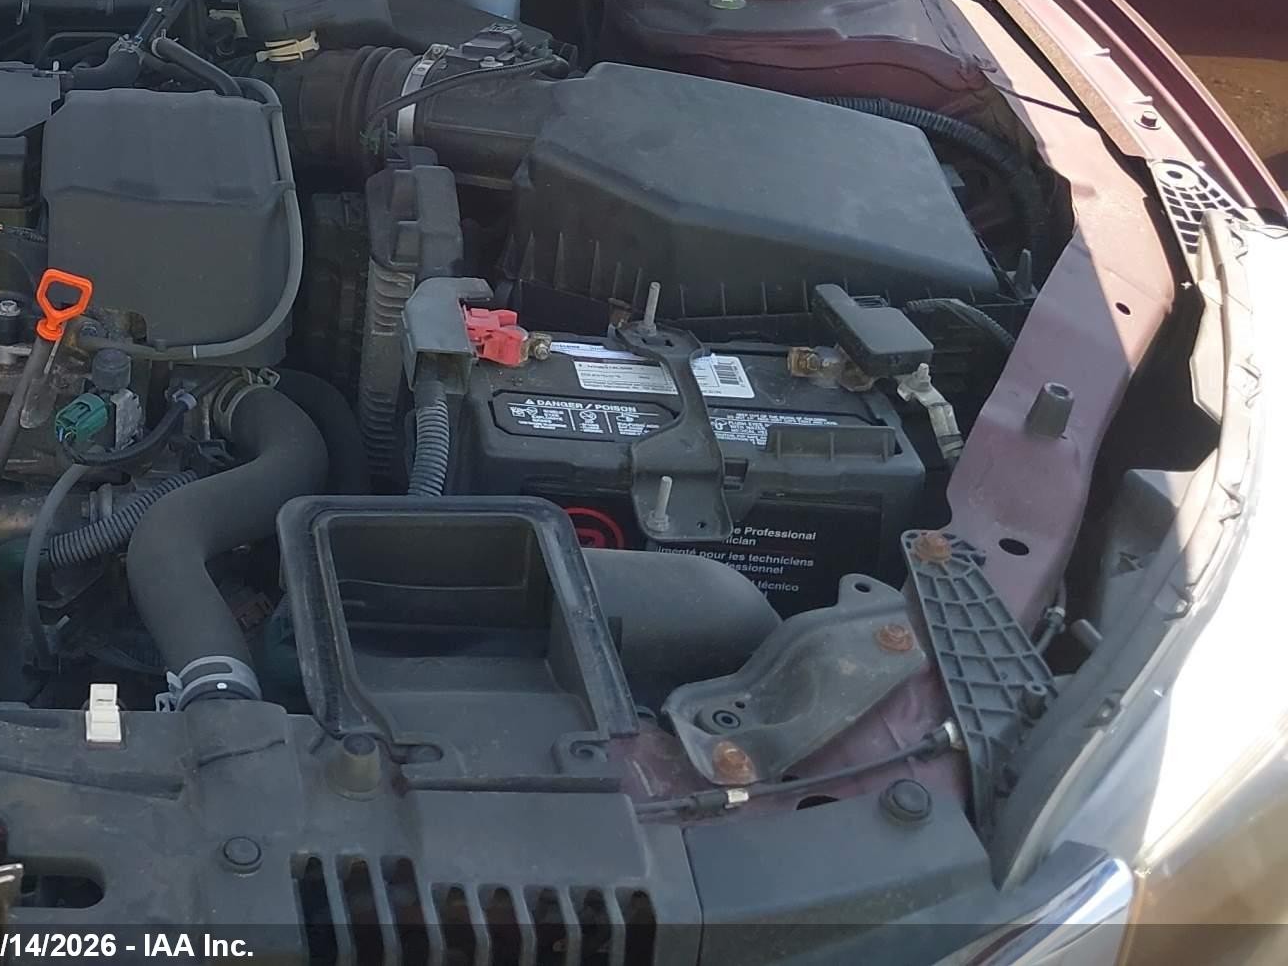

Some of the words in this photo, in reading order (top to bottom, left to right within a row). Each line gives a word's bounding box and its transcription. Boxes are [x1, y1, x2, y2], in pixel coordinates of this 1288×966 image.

[536, 399, 584, 410] DANGER
[594, 403, 637, 413] POISON
[744, 526, 817, 541] Professional
[699, 550, 727, 560] pour
[728, 551, 745, 561] les
[749, 553, 814, 567] techniciens
